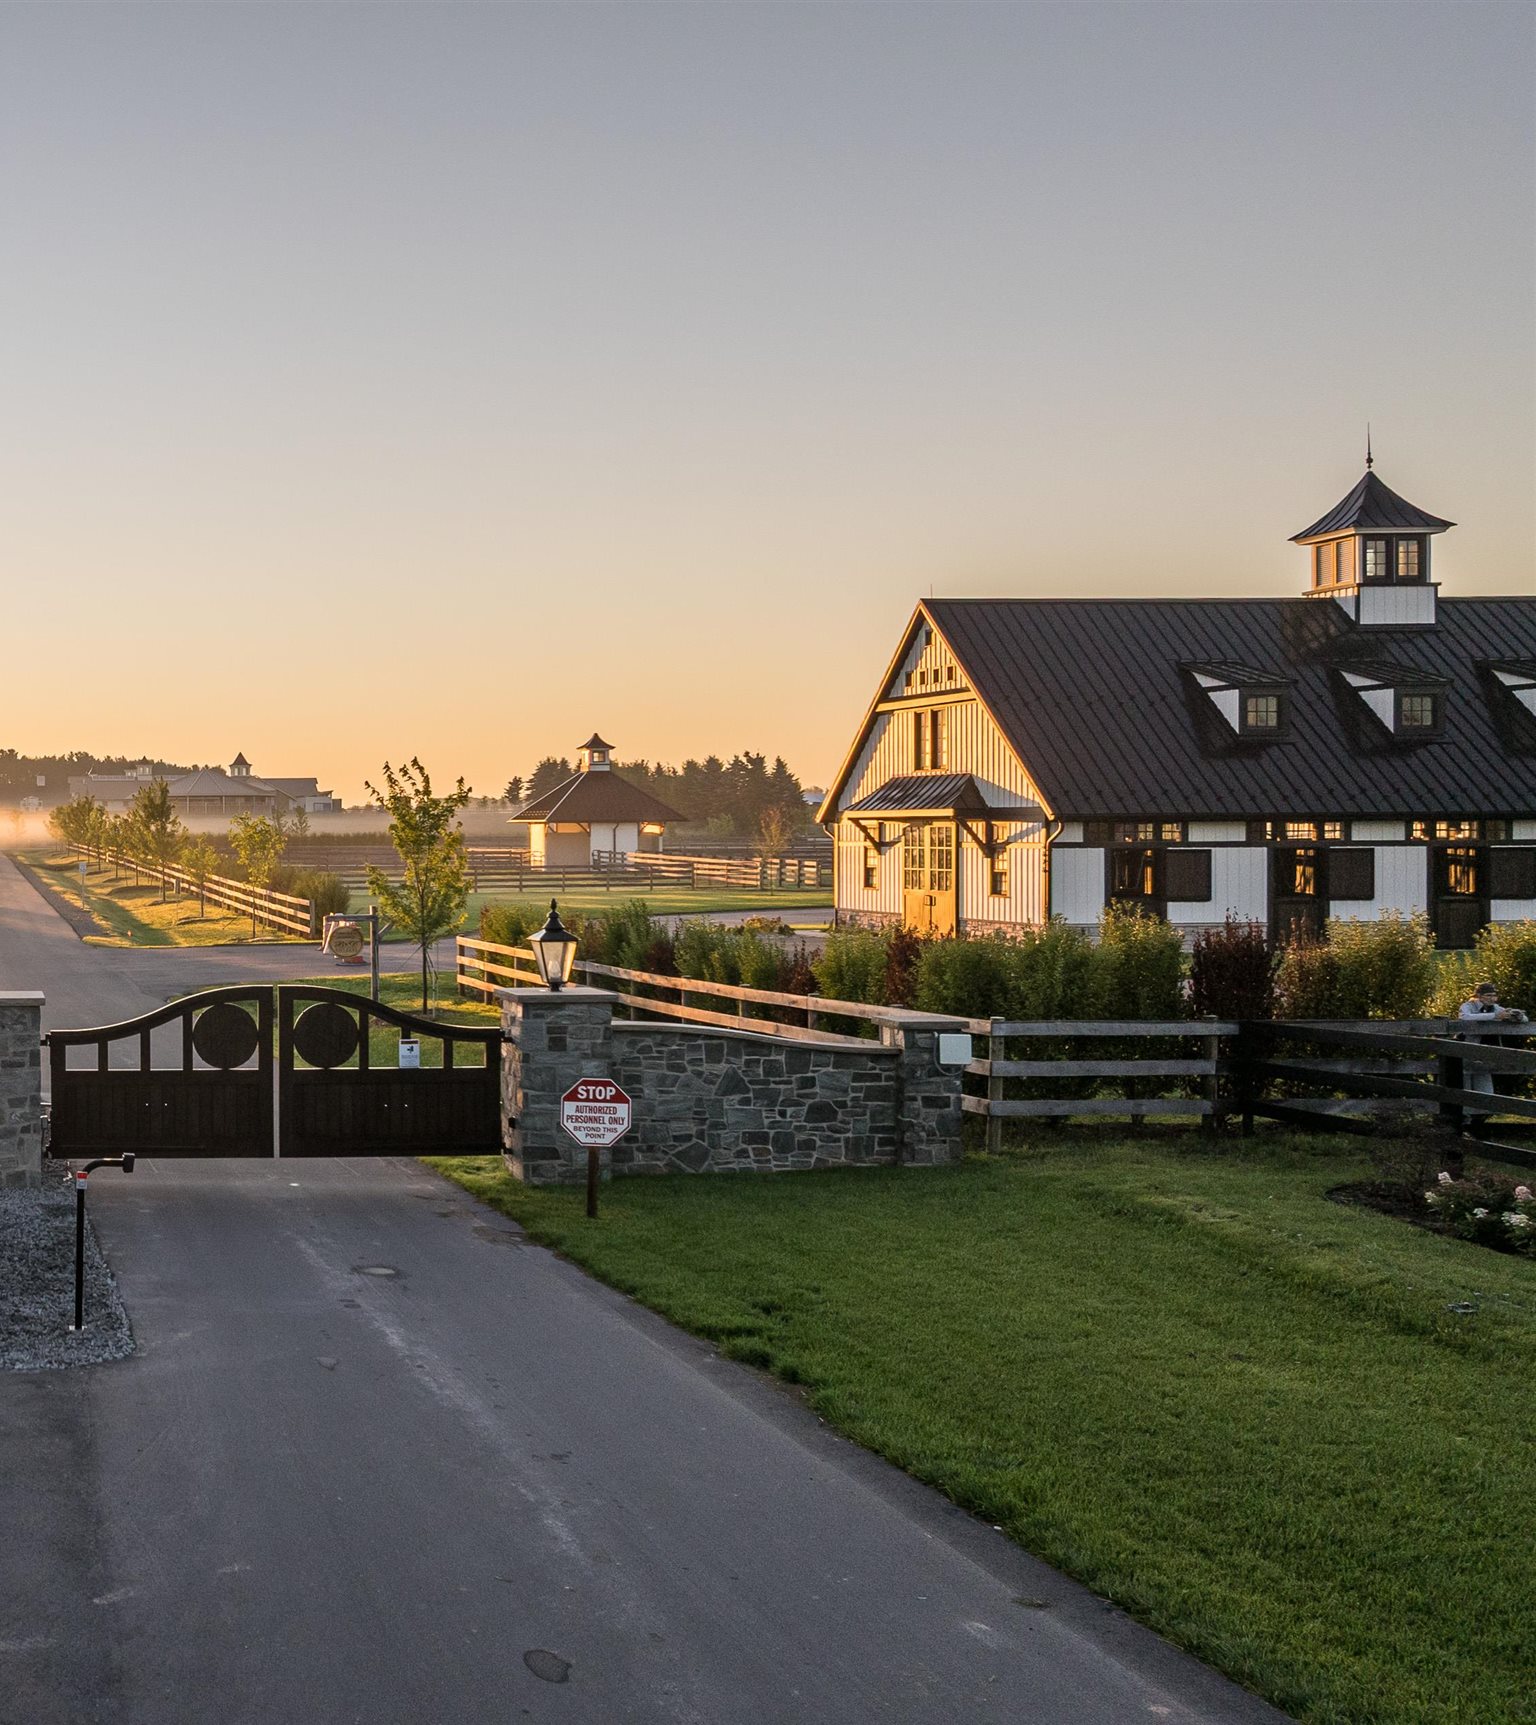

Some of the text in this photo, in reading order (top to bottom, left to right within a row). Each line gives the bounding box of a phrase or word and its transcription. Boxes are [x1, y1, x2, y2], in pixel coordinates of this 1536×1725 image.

[577, 1086, 616, 1100] STOP
[574, 1105, 617, 1114] AUTHORIZED
[566, 1115, 626, 1125] PERSONNEL ONLY
